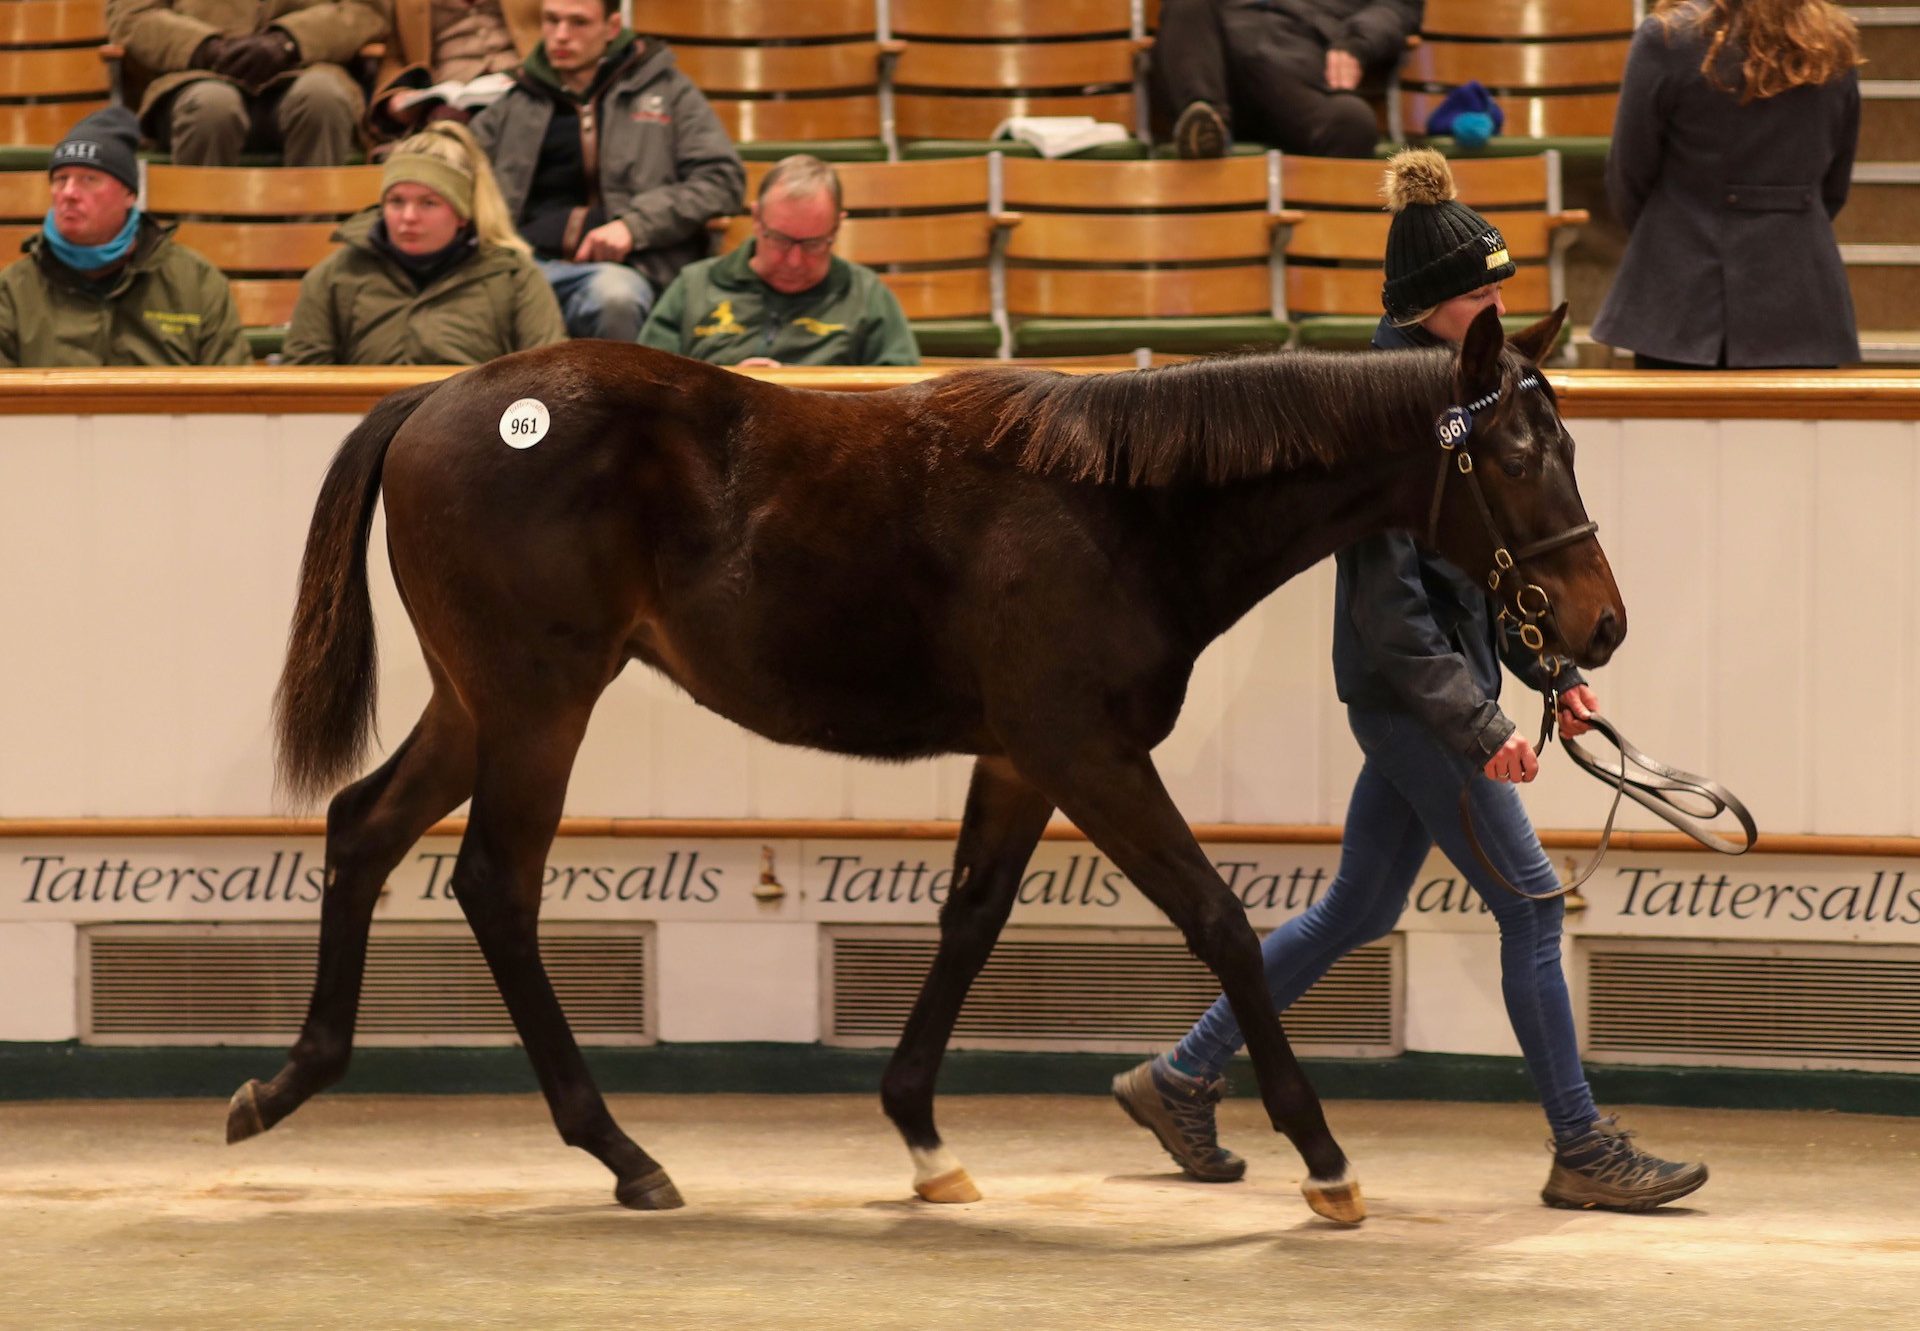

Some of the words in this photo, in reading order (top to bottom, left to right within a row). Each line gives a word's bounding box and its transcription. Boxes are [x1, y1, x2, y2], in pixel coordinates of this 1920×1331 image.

[511, 417, 538, 435] 961
[1440, 415, 1468, 444] 961
[20, 851, 325, 903] Tattersalls
[417, 852, 724, 902] Tersalls
[817, 855, 1125, 907] Tattealls
